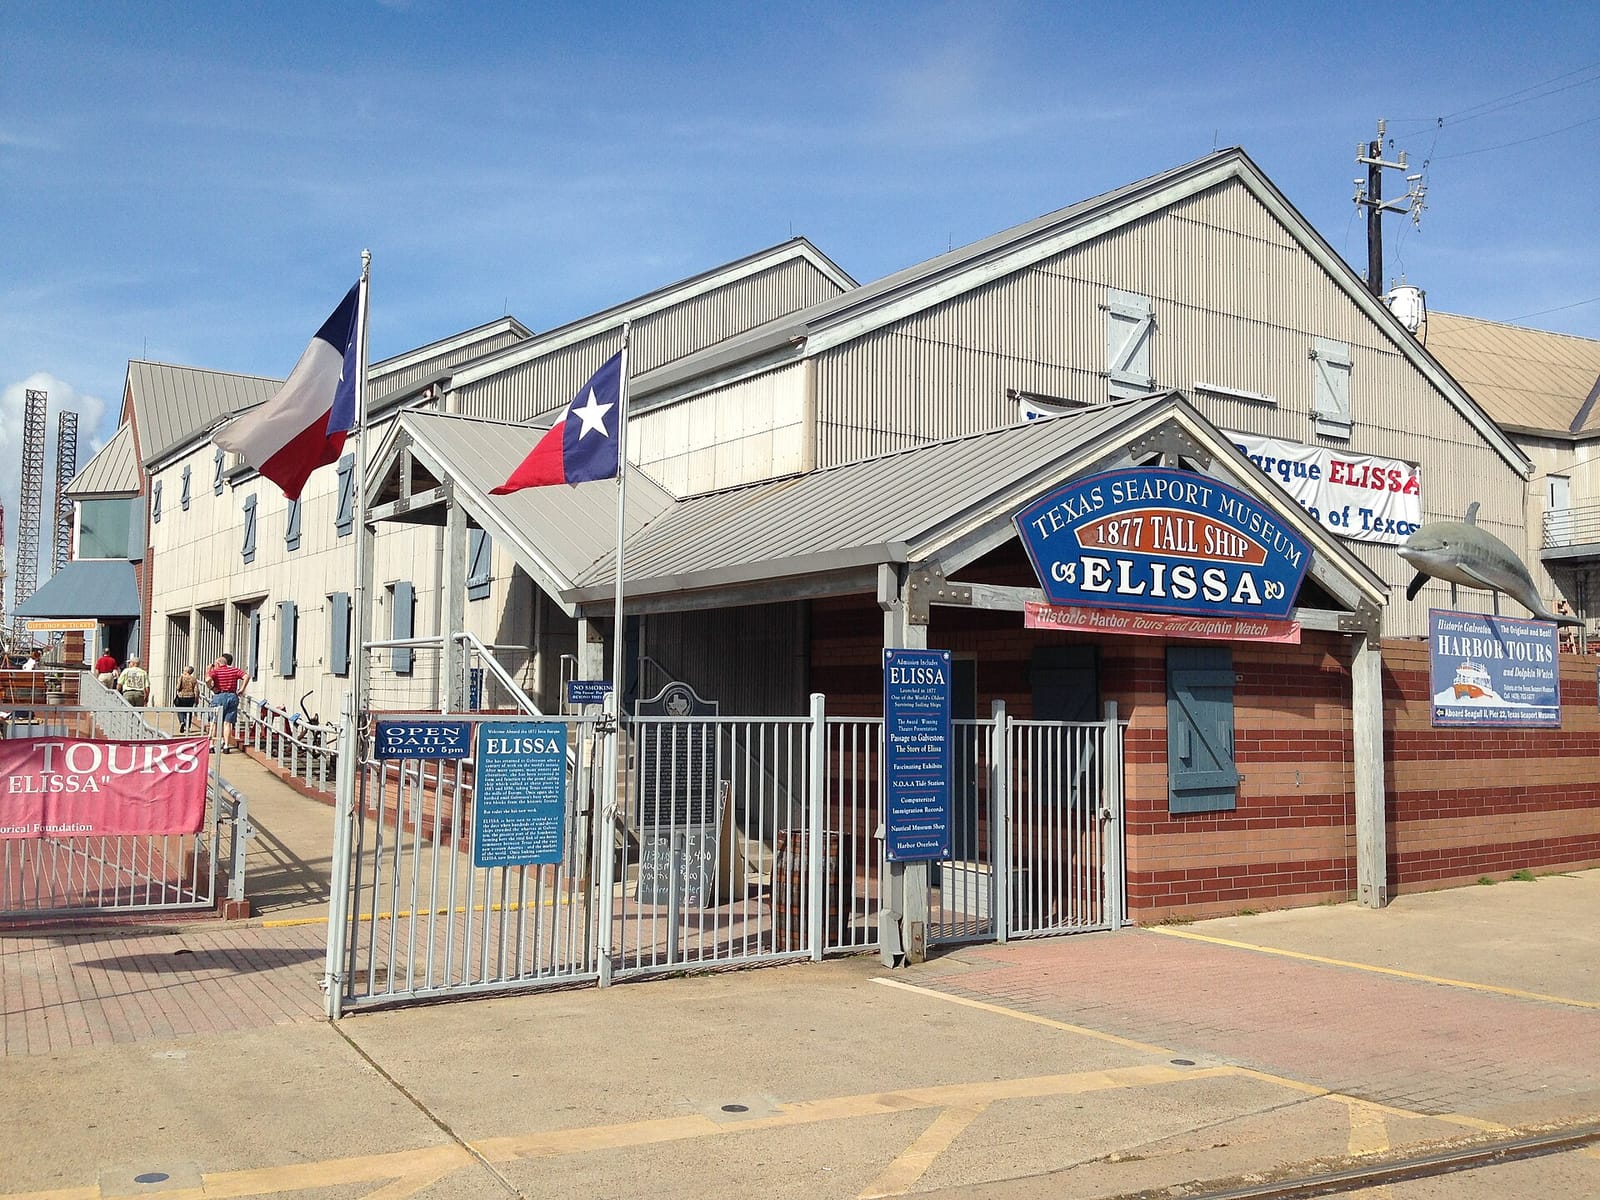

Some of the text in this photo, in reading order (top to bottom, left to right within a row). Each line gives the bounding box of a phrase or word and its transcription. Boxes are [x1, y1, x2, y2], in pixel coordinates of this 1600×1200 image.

[1234, 444, 1420, 497] arque ELISSA
[1032, 479, 1303, 570] TEXAS SEAPORT MUSEUM
[1329, 506, 1350, 529] of
[1096, 516, 1249, 559] 1877 TALL SHIP
[1080, 556, 1262, 606] ELISSA
[1037, 608, 1269, 637] Historic Harbor Tours and Dolphin Watch
[1438, 619, 1464, 632] Historic
[1438, 635, 1553, 663] HARBOR TOURS
[890, 667, 945, 685] ELISSA
[1514, 666, 1536, 680] Dolphin
[1536, 668, 1554, 680] Watch
[386, 727, 460, 736] OPEN
[388, 736, 460, 745] DAILY
[381, 746, 464, 755] 10am TO 5pm
[486, 738, 560, 754] ELISSA
[33, 742, 199, 775] TOURS
[8, 775, 111, 794] ELISSA"
[33, 822, 93, 833] Foundation
[897, 841, 915, 849] Harbor
